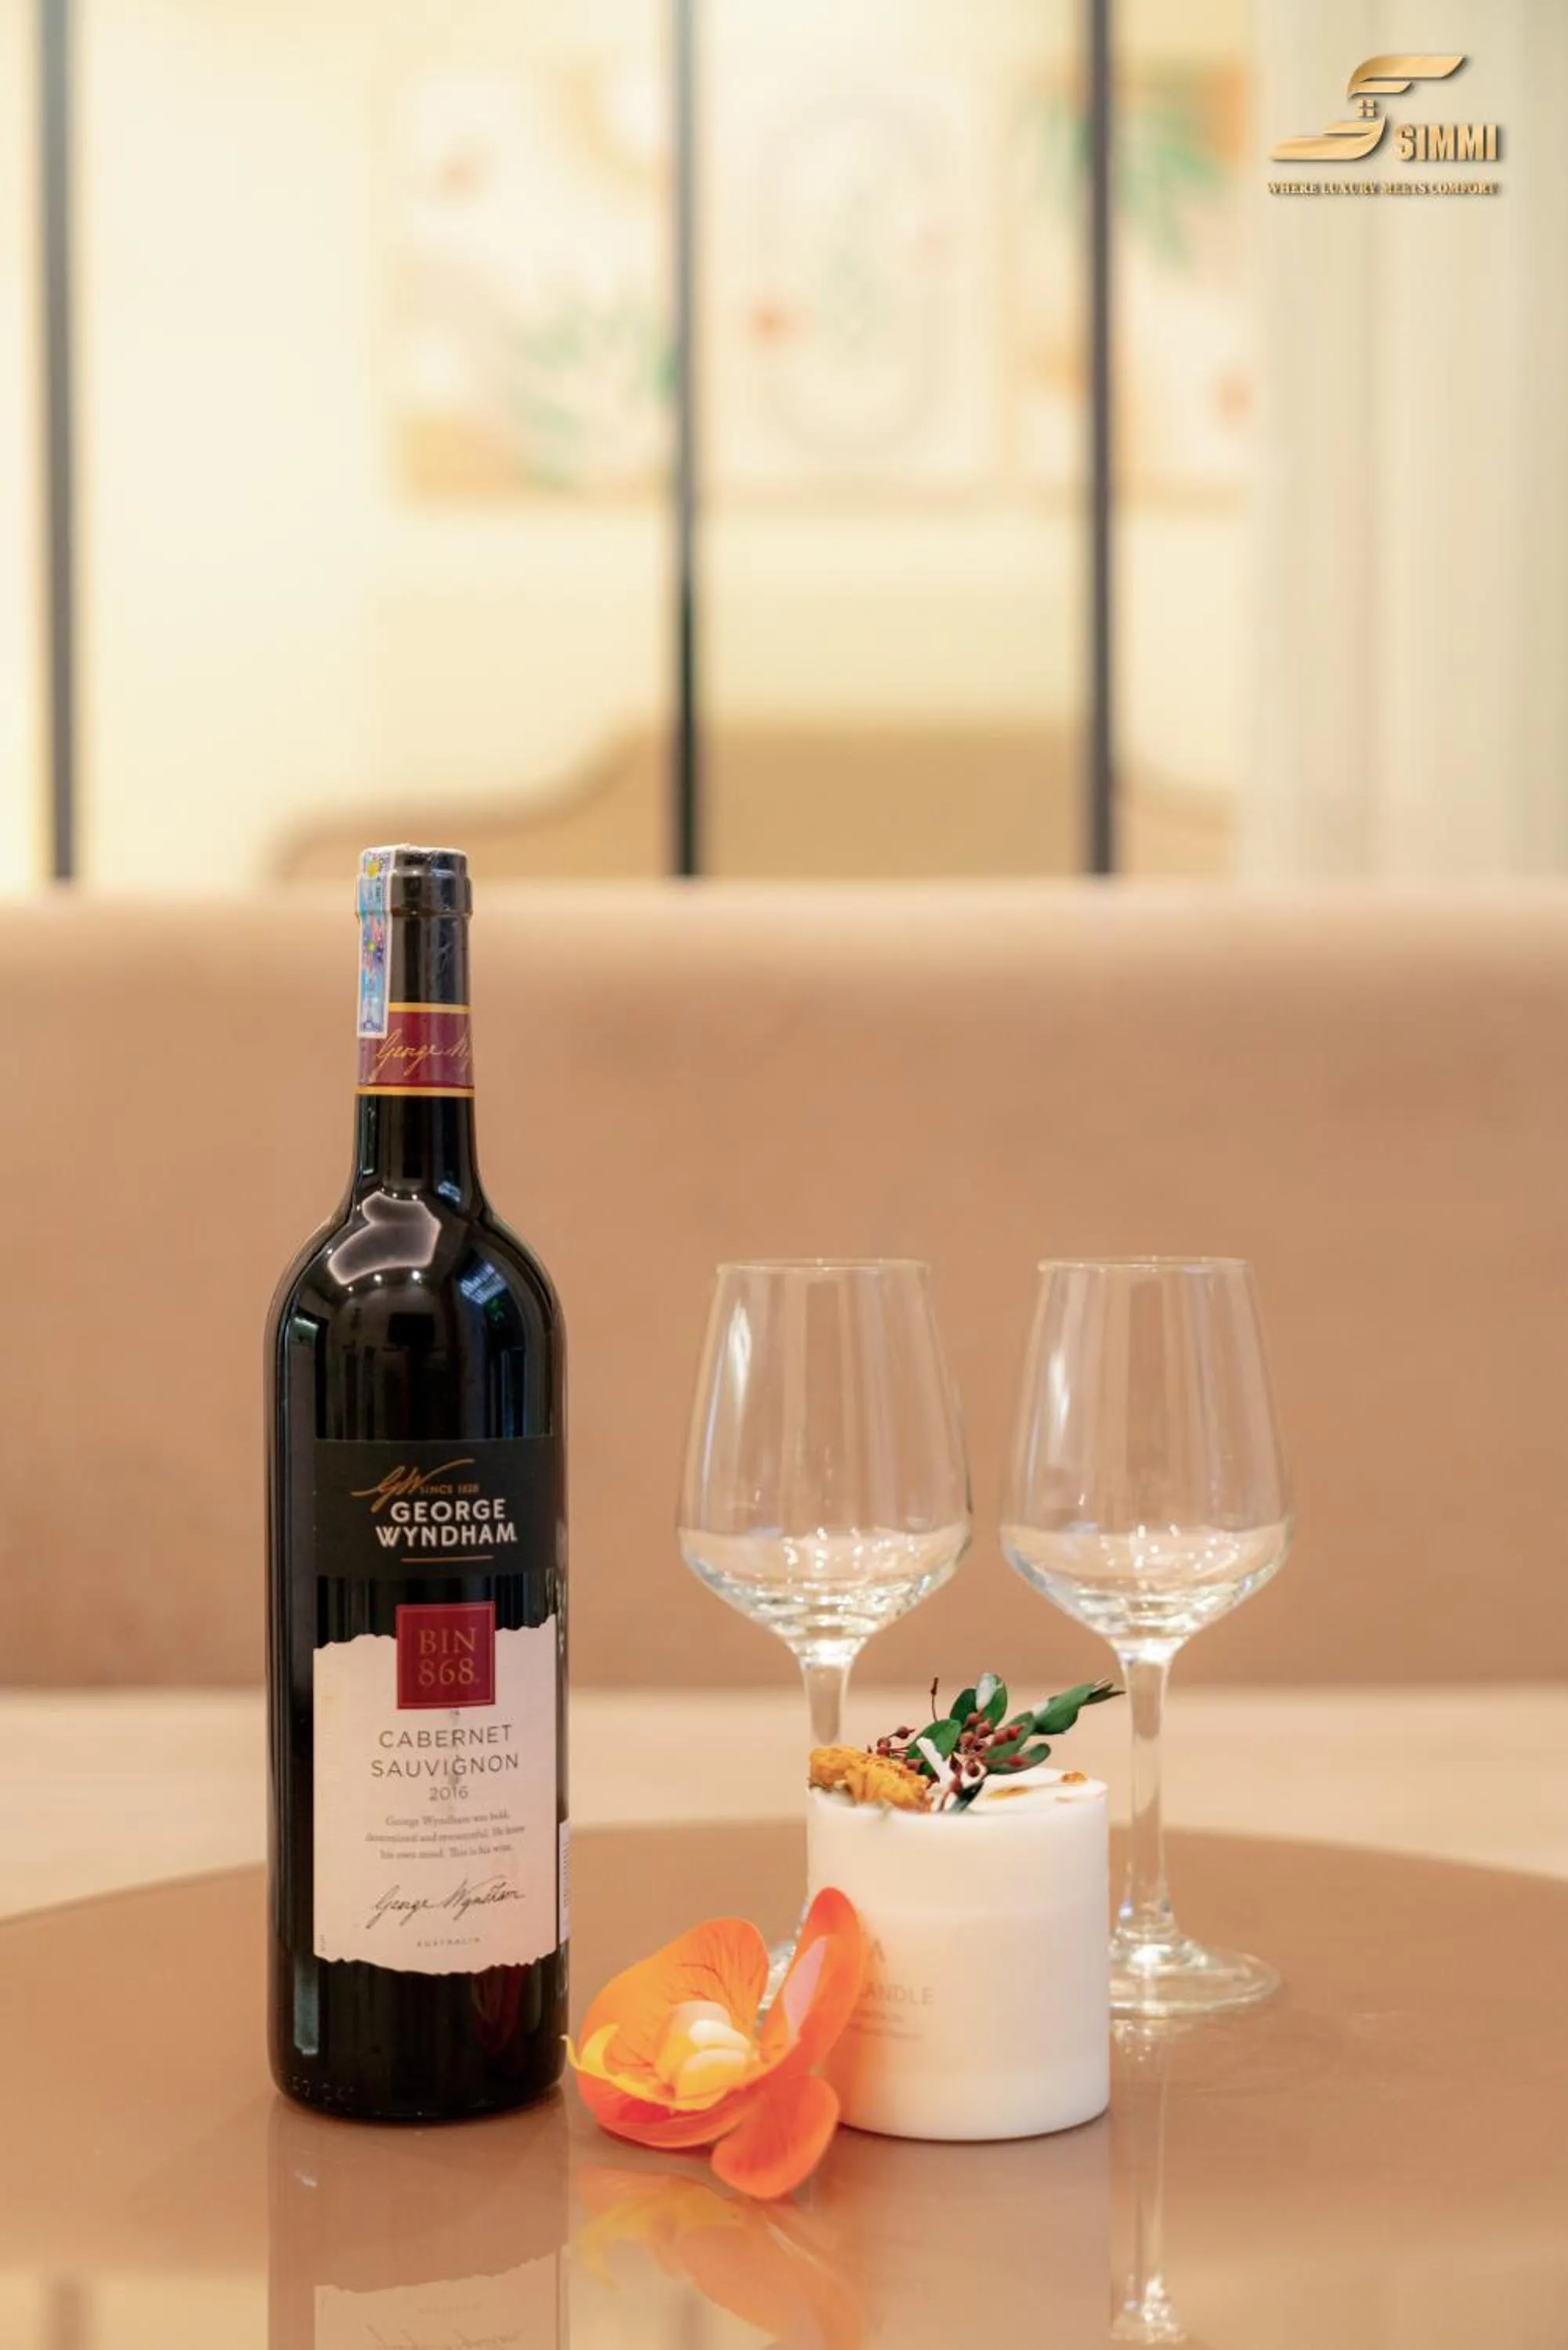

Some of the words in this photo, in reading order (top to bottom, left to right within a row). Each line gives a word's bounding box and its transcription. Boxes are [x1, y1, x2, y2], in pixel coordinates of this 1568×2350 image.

[390, 1498, 507, 1524] GEORGE
[375, 1522, 518, 1548] WYNDHAM
[418, 1627, 478, 1655] BIN
[417, 1658, 476, 1686] 868
[378, 1724, 512, 1749] CABERNET
[370, 1753, 519, 1778] SAUVIGNON
[428, 1785, 468, 1802] 2016
